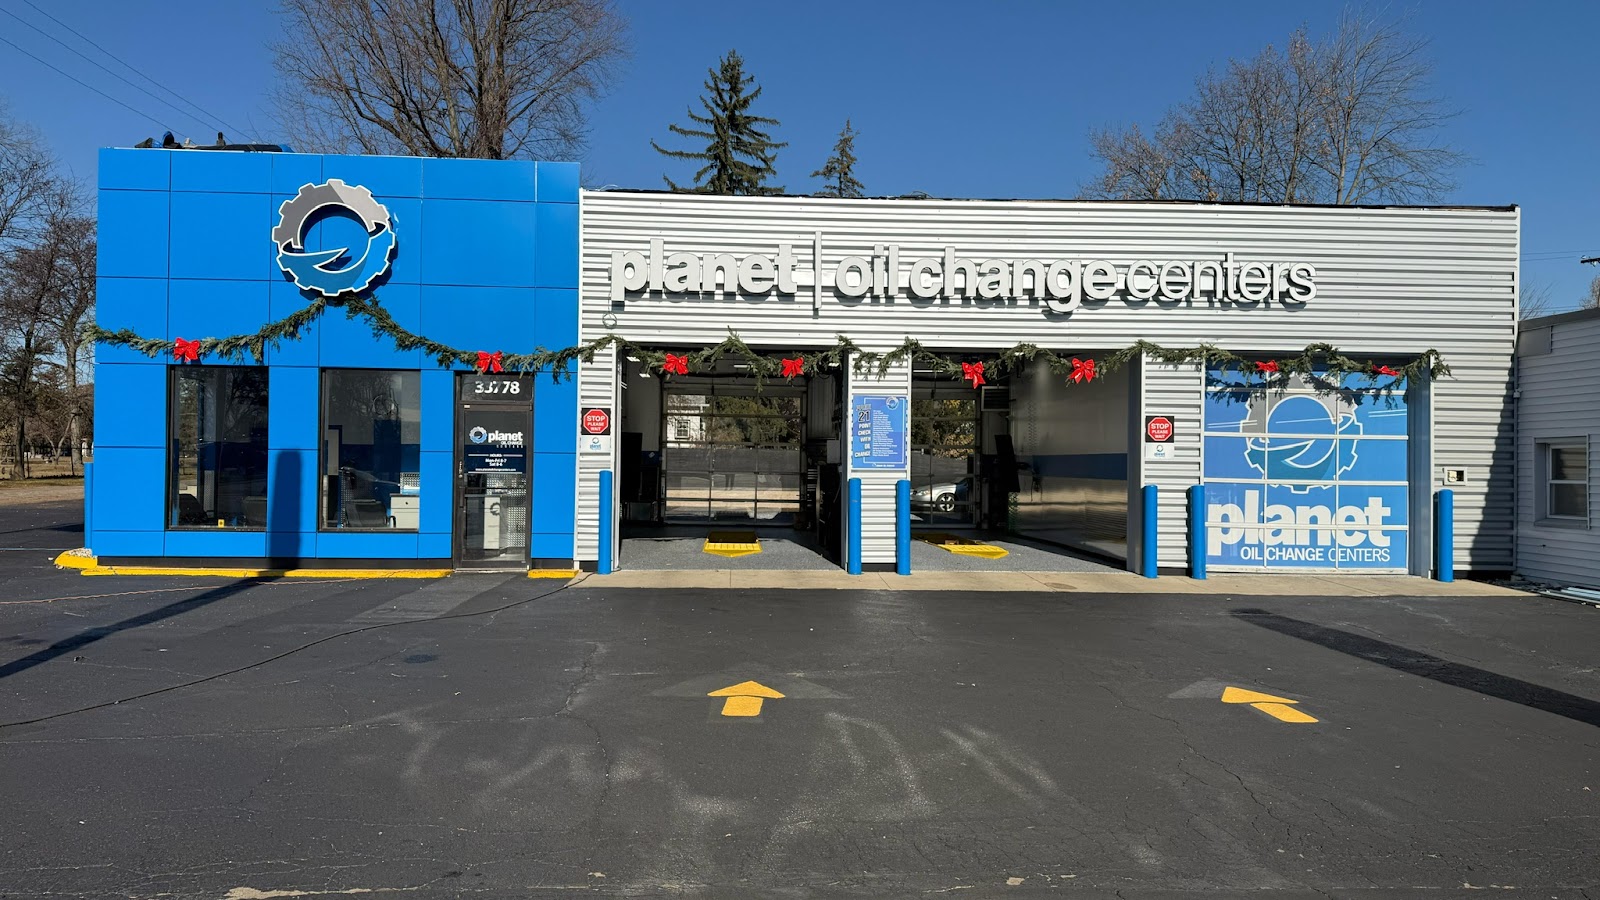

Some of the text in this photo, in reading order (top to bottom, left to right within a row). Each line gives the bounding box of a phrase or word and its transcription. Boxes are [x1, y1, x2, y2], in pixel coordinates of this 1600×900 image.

[611, 238, 797, 301] planet
[836, 244, 1317, 312] oil change centers
[858, 410, 870, 422] 21
[488, 430, 524, 443] planet
[1207, 490, 1391, 556] planet
[1240, 546, 1390, 562] OIL CHANGE CENTERS
